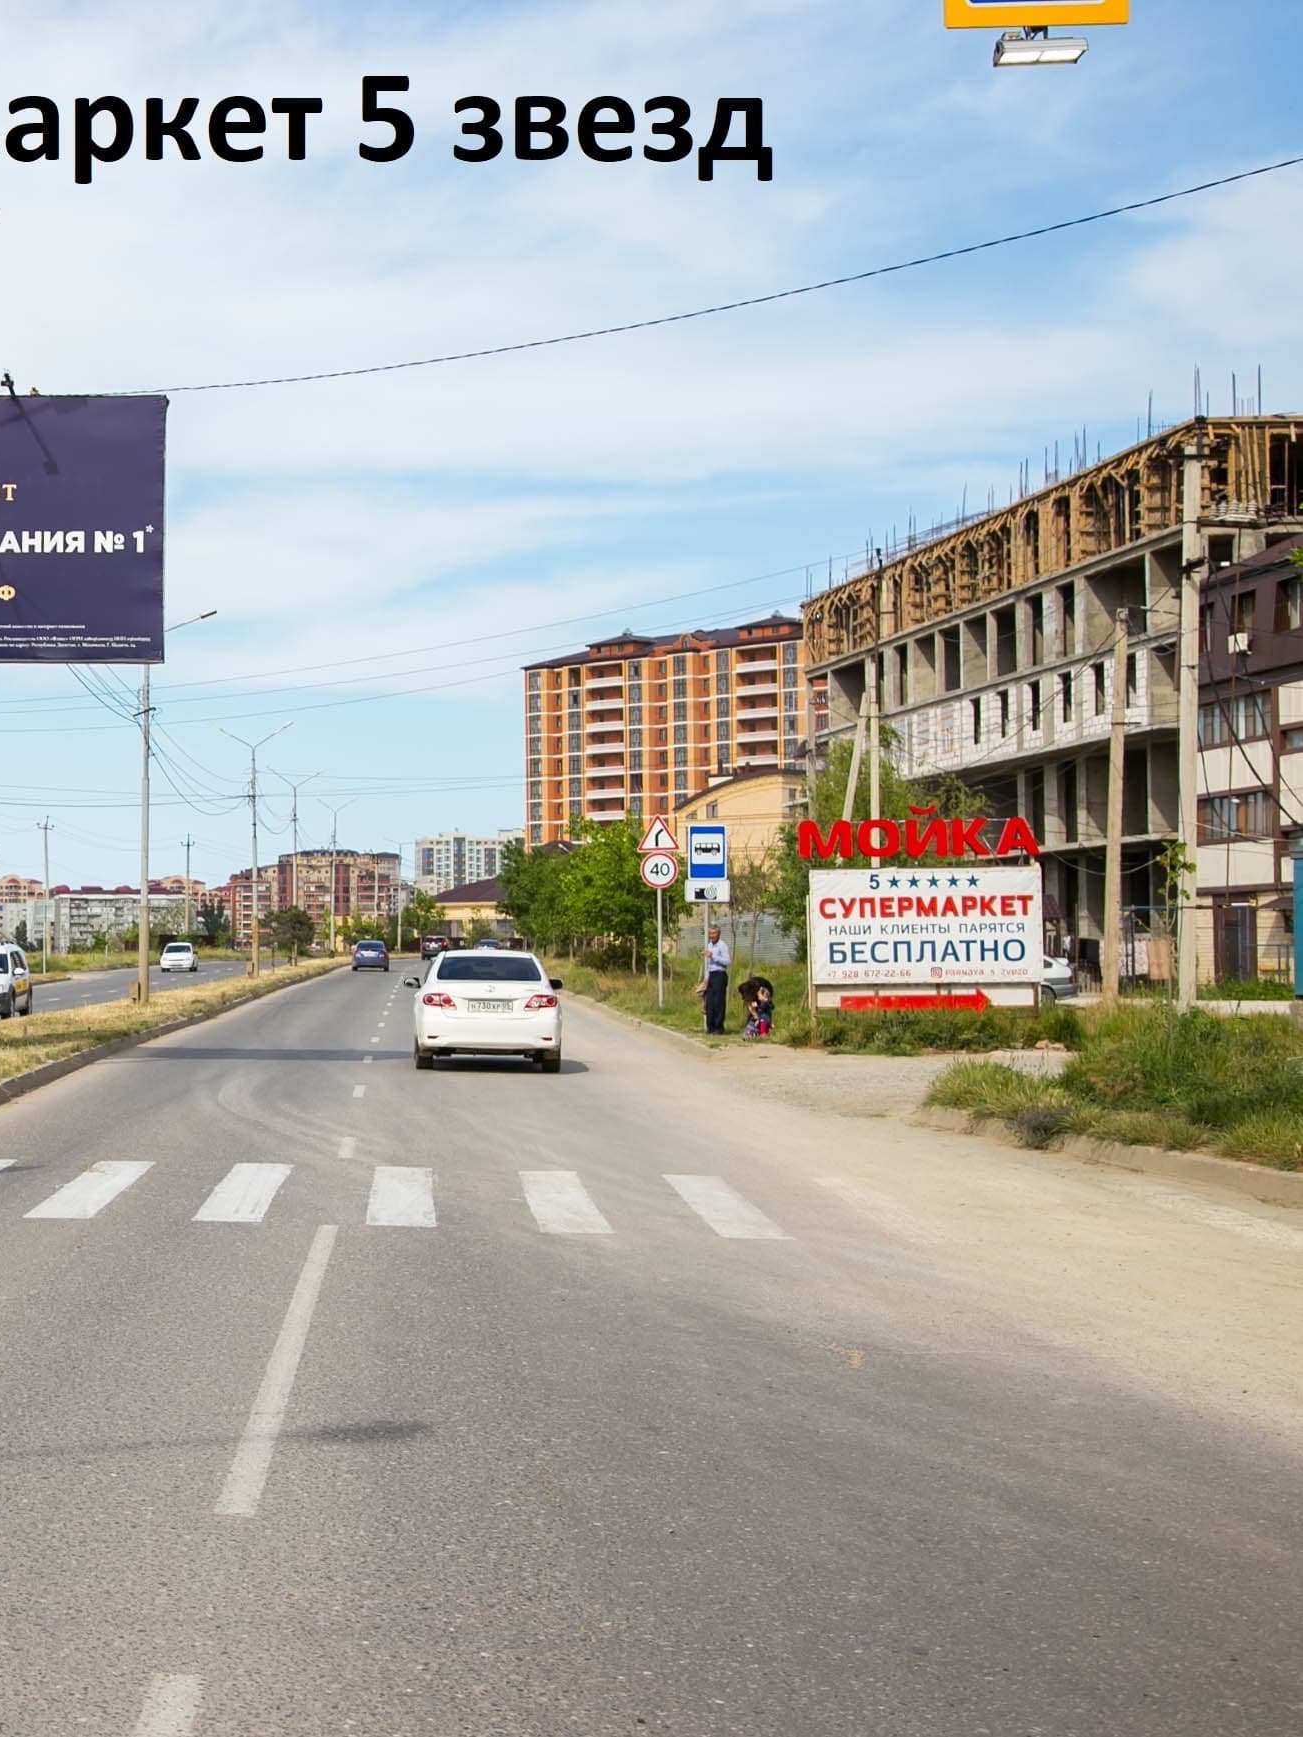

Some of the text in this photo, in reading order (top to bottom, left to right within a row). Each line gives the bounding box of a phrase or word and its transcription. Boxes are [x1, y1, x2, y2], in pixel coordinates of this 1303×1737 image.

[94, 530, 125, 553] №
[797, 804, 1040, 859] МОЙКА
[650, 863, 670, 876] 40
[869, 874, 880, 890] 5
[818, 894, 1033, 919] СУПЕРМАРКЕТ
[829, 922, 1025, 935] НАШИ КЛИЕНТЫ ПАРЯТСЯ
[829, 938, 1027, 964] БЕСПЛАТНО
